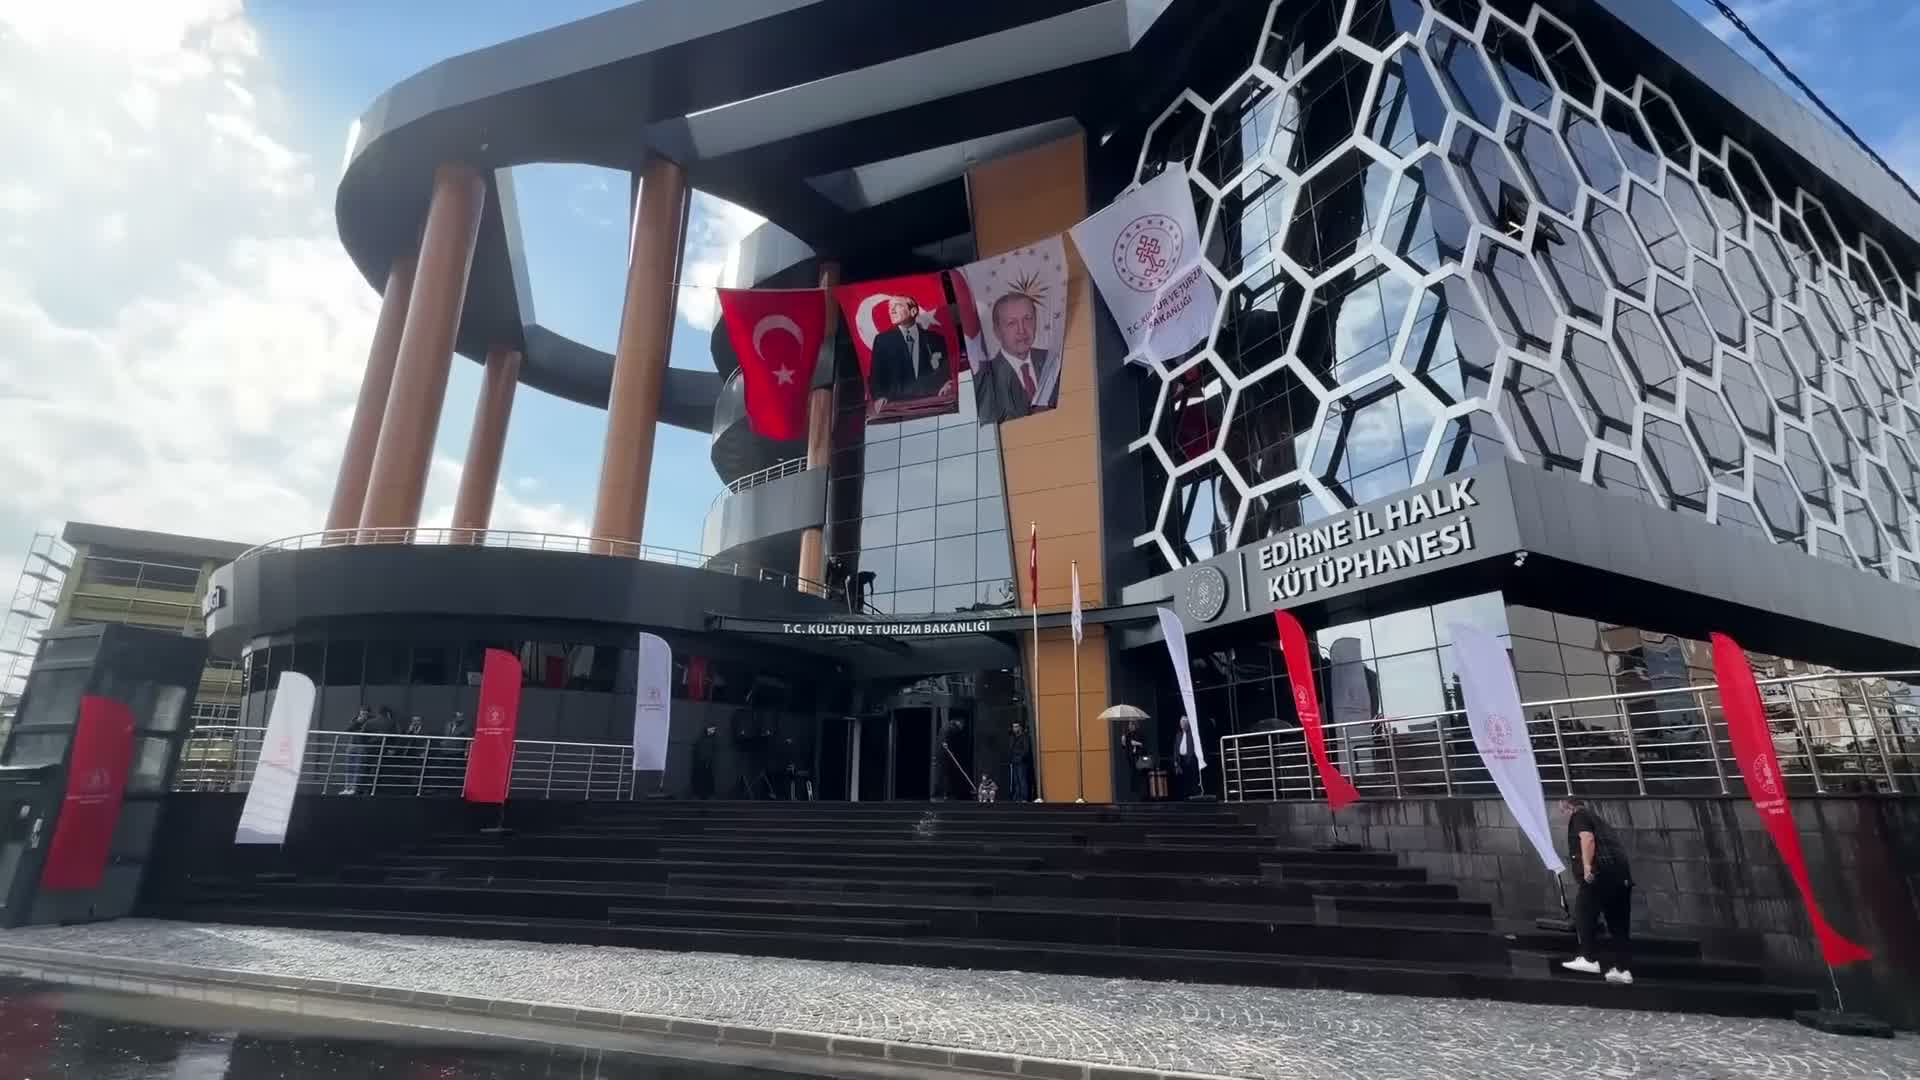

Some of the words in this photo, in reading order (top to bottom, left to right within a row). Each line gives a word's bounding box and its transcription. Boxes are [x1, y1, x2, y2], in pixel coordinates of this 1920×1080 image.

[1258, 519, 1349, 569] EDİRNE
[1353, 509, 1381, 540] İL
[1385, 477, 1478, 530] HALK
[1268, 516, 1473, 601] KÜTÜPHANESİ
[783, 623, 805, 634] T.C.
[857, 624, 873, 635] VE
[874, 623, 921, 635] TURİZM
[924, 620, 990, 634] BAKANLIĞI
